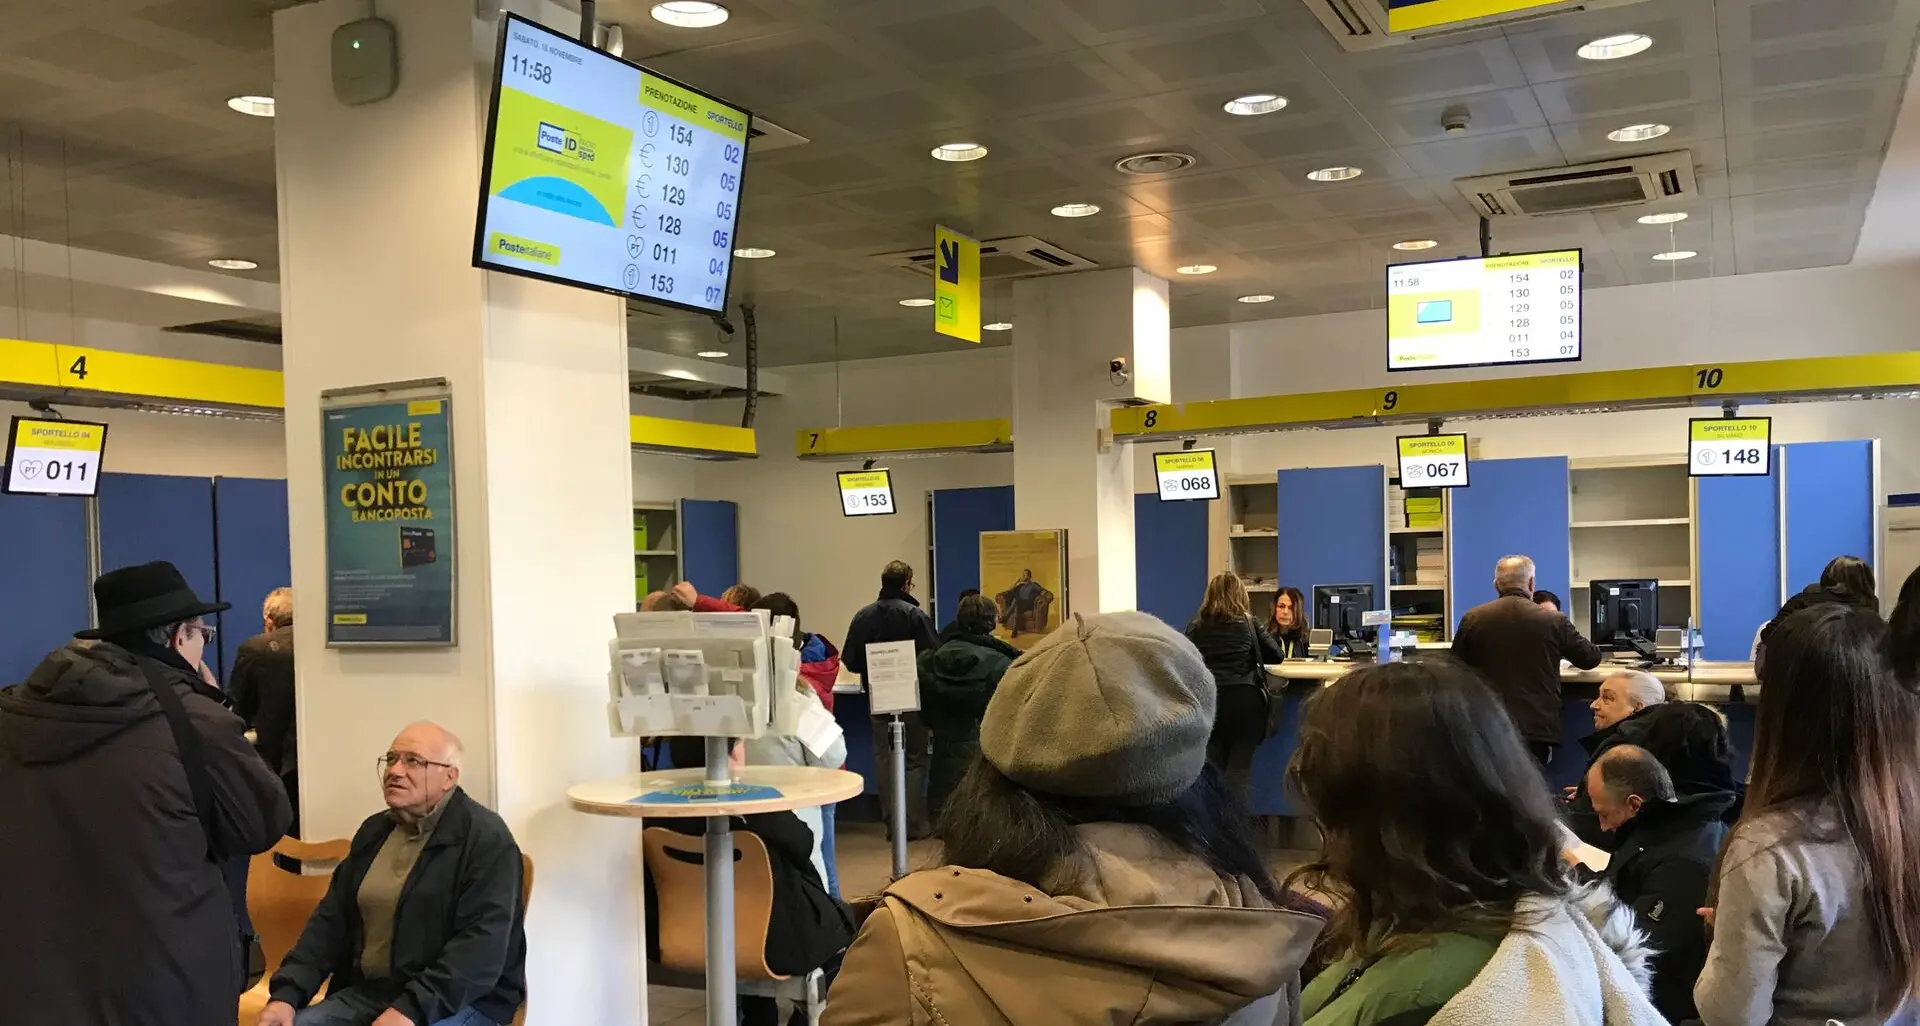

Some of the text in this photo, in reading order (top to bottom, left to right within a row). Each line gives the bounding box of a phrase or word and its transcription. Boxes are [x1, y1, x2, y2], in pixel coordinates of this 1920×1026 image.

[512, 54, 552, 84] 11:58
[645, 86, 743, 132] PRENOTAZIONE SPORTELLO
[541, 130, 562, 146] Poste
[565, 137, 577, 151] ID
[669, 124, 693, 147] 154
[724, 144, 739, 164] 02
[666, 154, 689, 176] 130
[720, 172, 736, 192] 05
[662, 184, 685, 206] 129
[716, 201, 732, 220] 05
[658, 214, 681, 235] 128
[713, 230, 728, 248] 05
[653, 243, 677, 264] 011
[709, 258, 724, 276] 04
[1486, 260, 1529, 268] PRENOTAZIONE
[1394, 278, 1420, 288] 11:58
[1510, 269, 1574, 283] 154 02
[650, 273, 674, 294] 153
[705, 286, 721, 304] 07
[1510, 285, 1574, 298] 130 05
[1510, 300, 1574, 313] 129 05
[1510, 315, 1574, 328] 128 05
[1508, 330, 1574, 343] 011 04
[1510, 345, 1574, 357] 153 07
[70, 355, 87, 379] 4
[1696, 368, 1723, 389] 10
[1383, 391, 1398, 410] 9
[1144, 410, 1157, 428] 8
[32, 427, 80, 438] SPORTELLO
[343, 422, 421, 452] FACILE
[809, 433, 818, 449] 7
[337, 449, 437, 470] INCONTRARSI
[1164, 457, 1197, 465] SPORTELLO
[1722, 448, 1760, 464] 148
[46, 460, 87, 481] 011
[375, 469, 400, 479] IN UN
[1426, 463, 1459, 477] 067
[1181, 476, 1211, 491] 068
[341, 479, 427, 507] CONTO
[863, 494, 887, 506] 153
[352, 507, 432, 523] BANCOPOSTA
